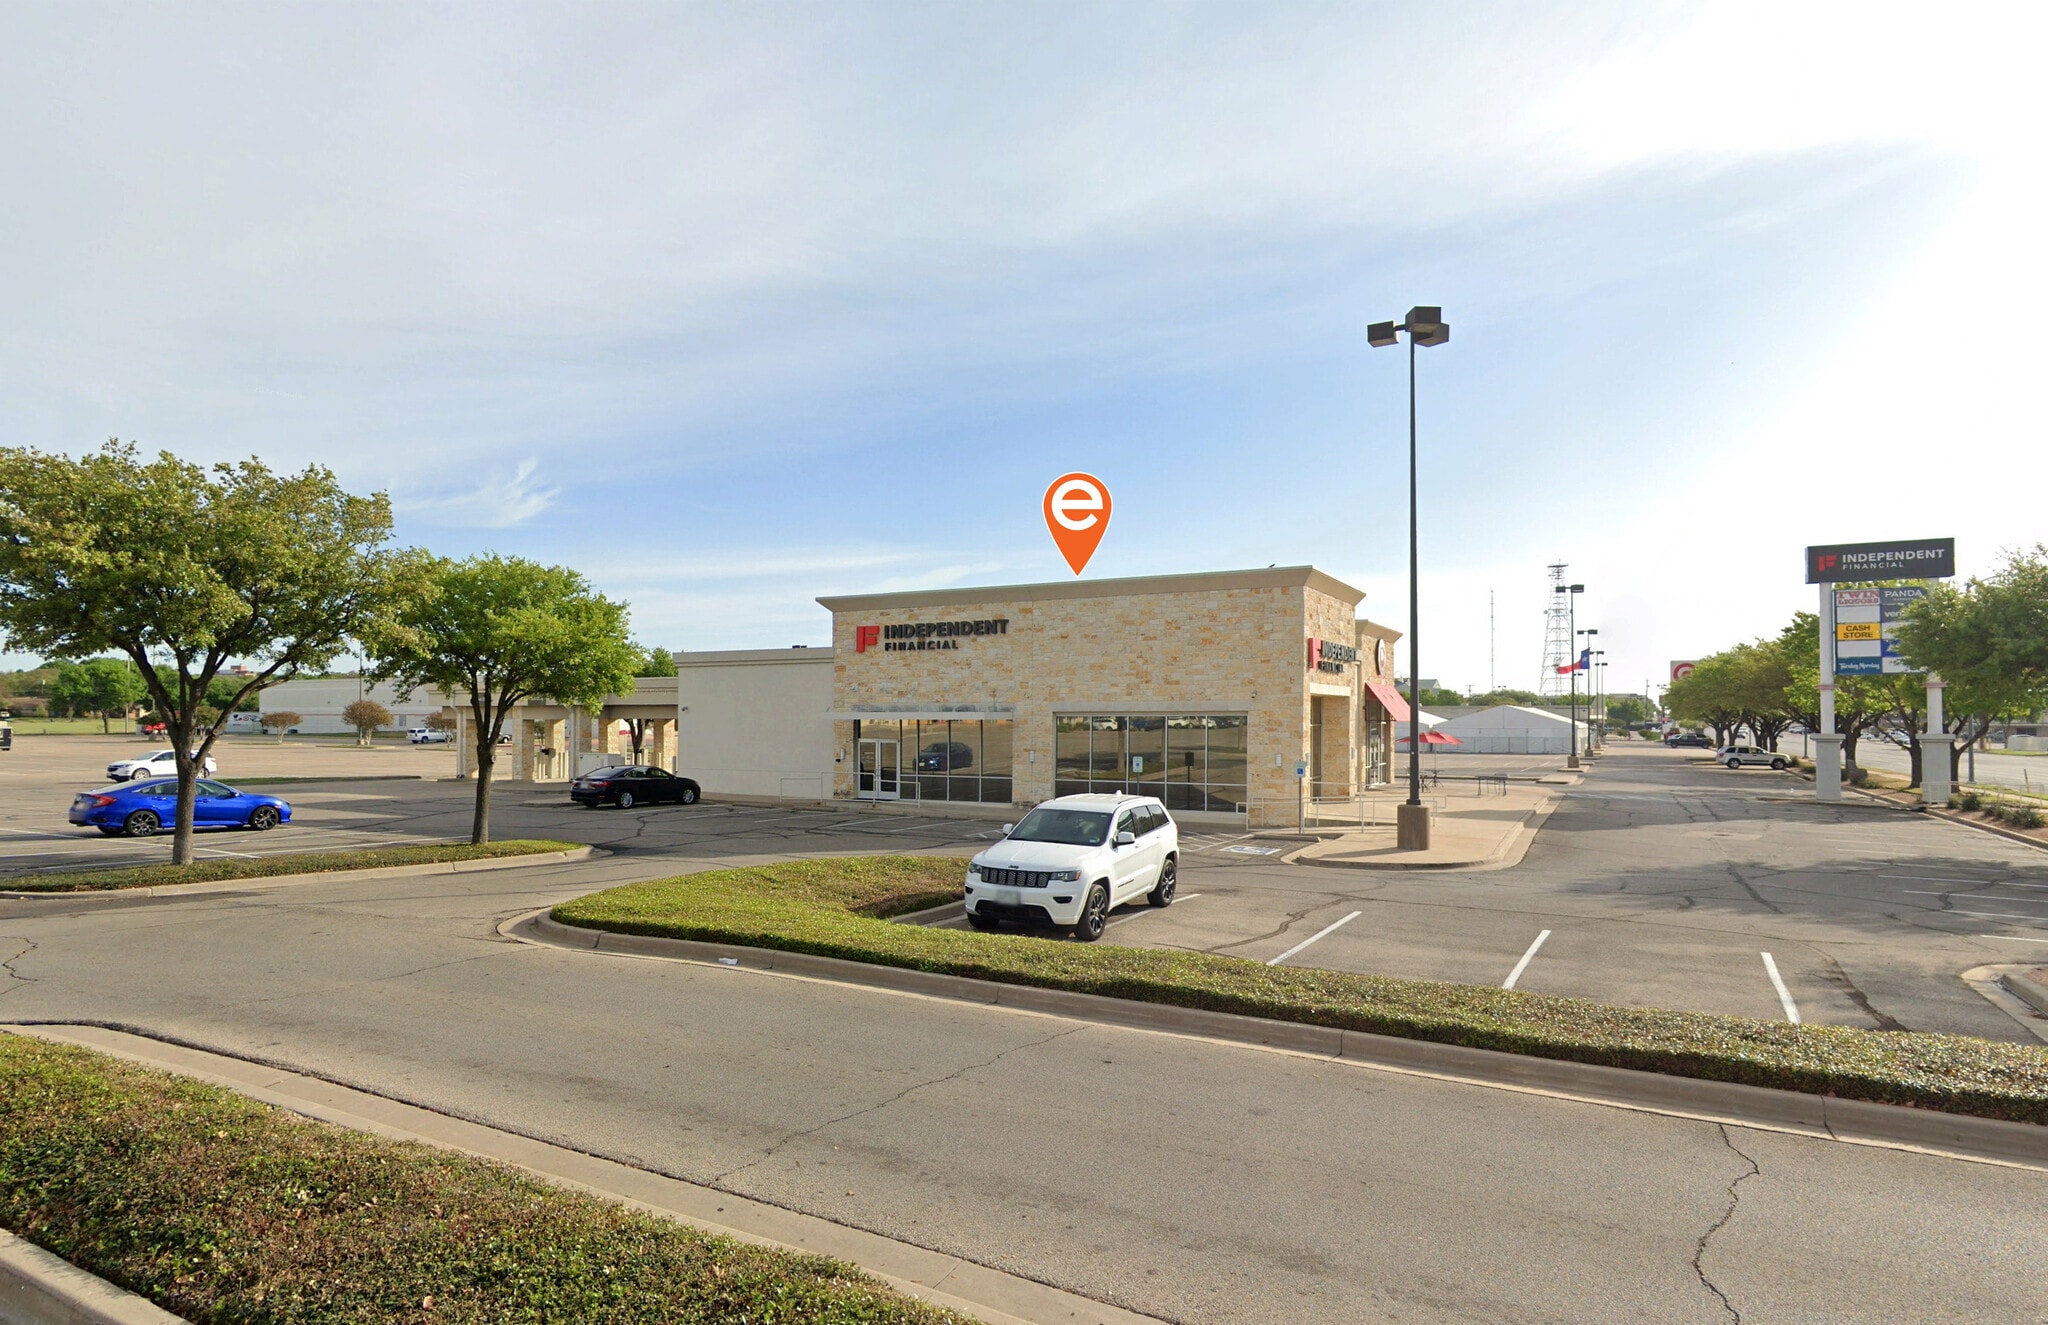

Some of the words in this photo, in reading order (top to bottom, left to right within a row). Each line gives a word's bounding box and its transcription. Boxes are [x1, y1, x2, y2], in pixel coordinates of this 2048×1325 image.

[1842, 549, 1945, 563] INDEPENDENT
[1842, 562, 1904, 570] FINANCIAL
[1884, 589, 1923, 598] PANDA
[884, 619, 1010, 639] INDEPENDENT
[1845, 624, 1871, 632] CASH
[1843, 631, 1874, 639] STORE
[884, 640, 960, 652] FINANCIAL
